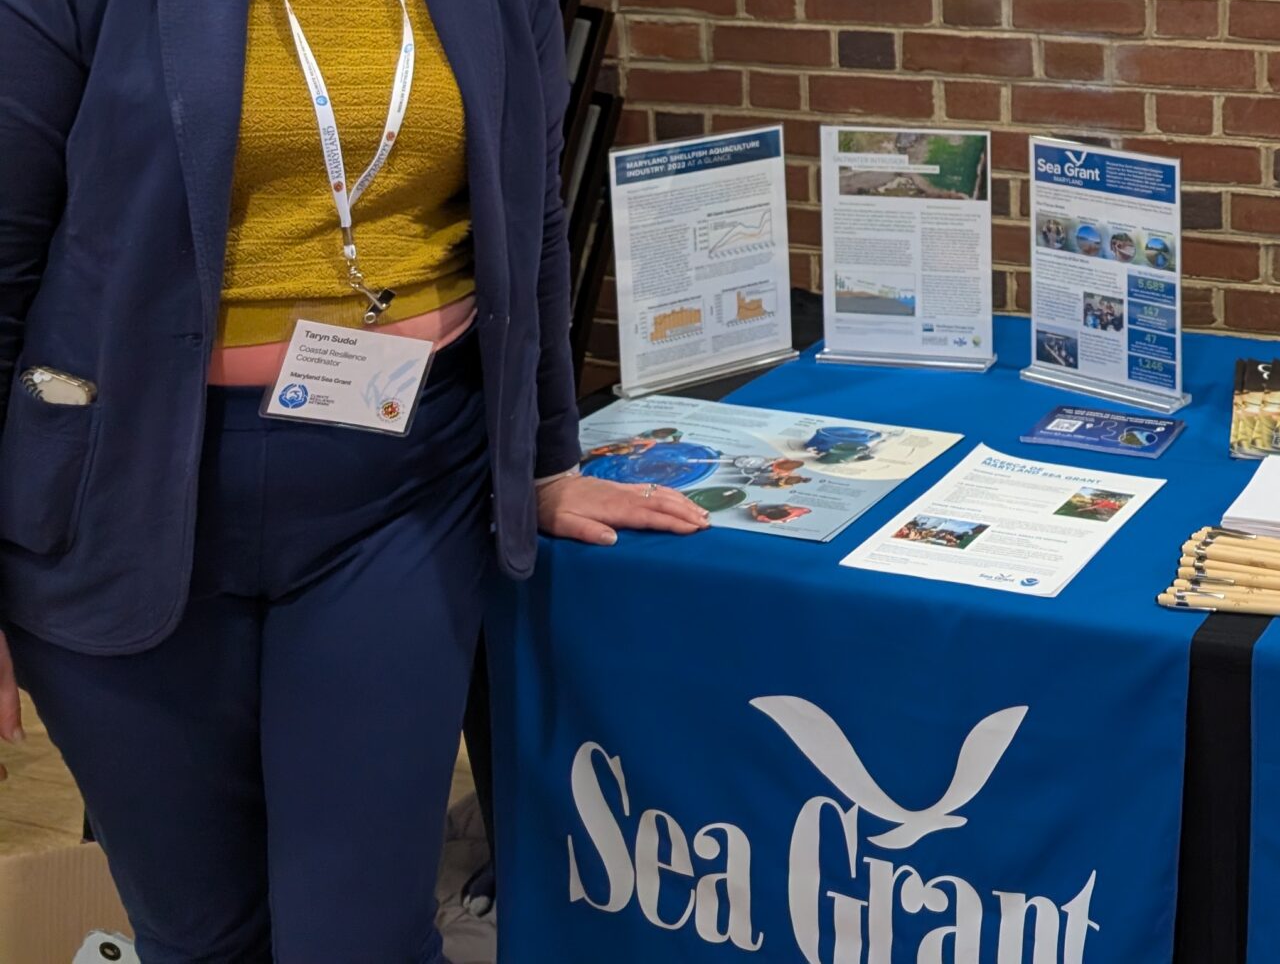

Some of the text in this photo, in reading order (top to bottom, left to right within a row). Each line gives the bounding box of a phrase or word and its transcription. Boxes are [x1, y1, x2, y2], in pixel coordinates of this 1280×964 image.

[326, 125, 344, 180] MARYLAND
[626, 140, 760, 170] MARYLAND SHELLFISH AQUACULTURE
[1037, 158, 1061, 175] Sea
[1064, 162, 1100, 181] Grant
[1053, 176, 1083, 186] MARYLAND
[304, 330, 358, 346] Taryn Sudol
[295, 354, 341, 367] Coordinator
[299, 344, 367, 362] Coastal Resilience
[290, 371, 352, 386] Maryland Sea Grant
[981, 460, 1103, 484] MARYLAND SEA GRANT
[986, 457, 1027, 469] ACERCA
[568, 741, 764, 952] Sea
[788, 796, 1100, 964] Grant
